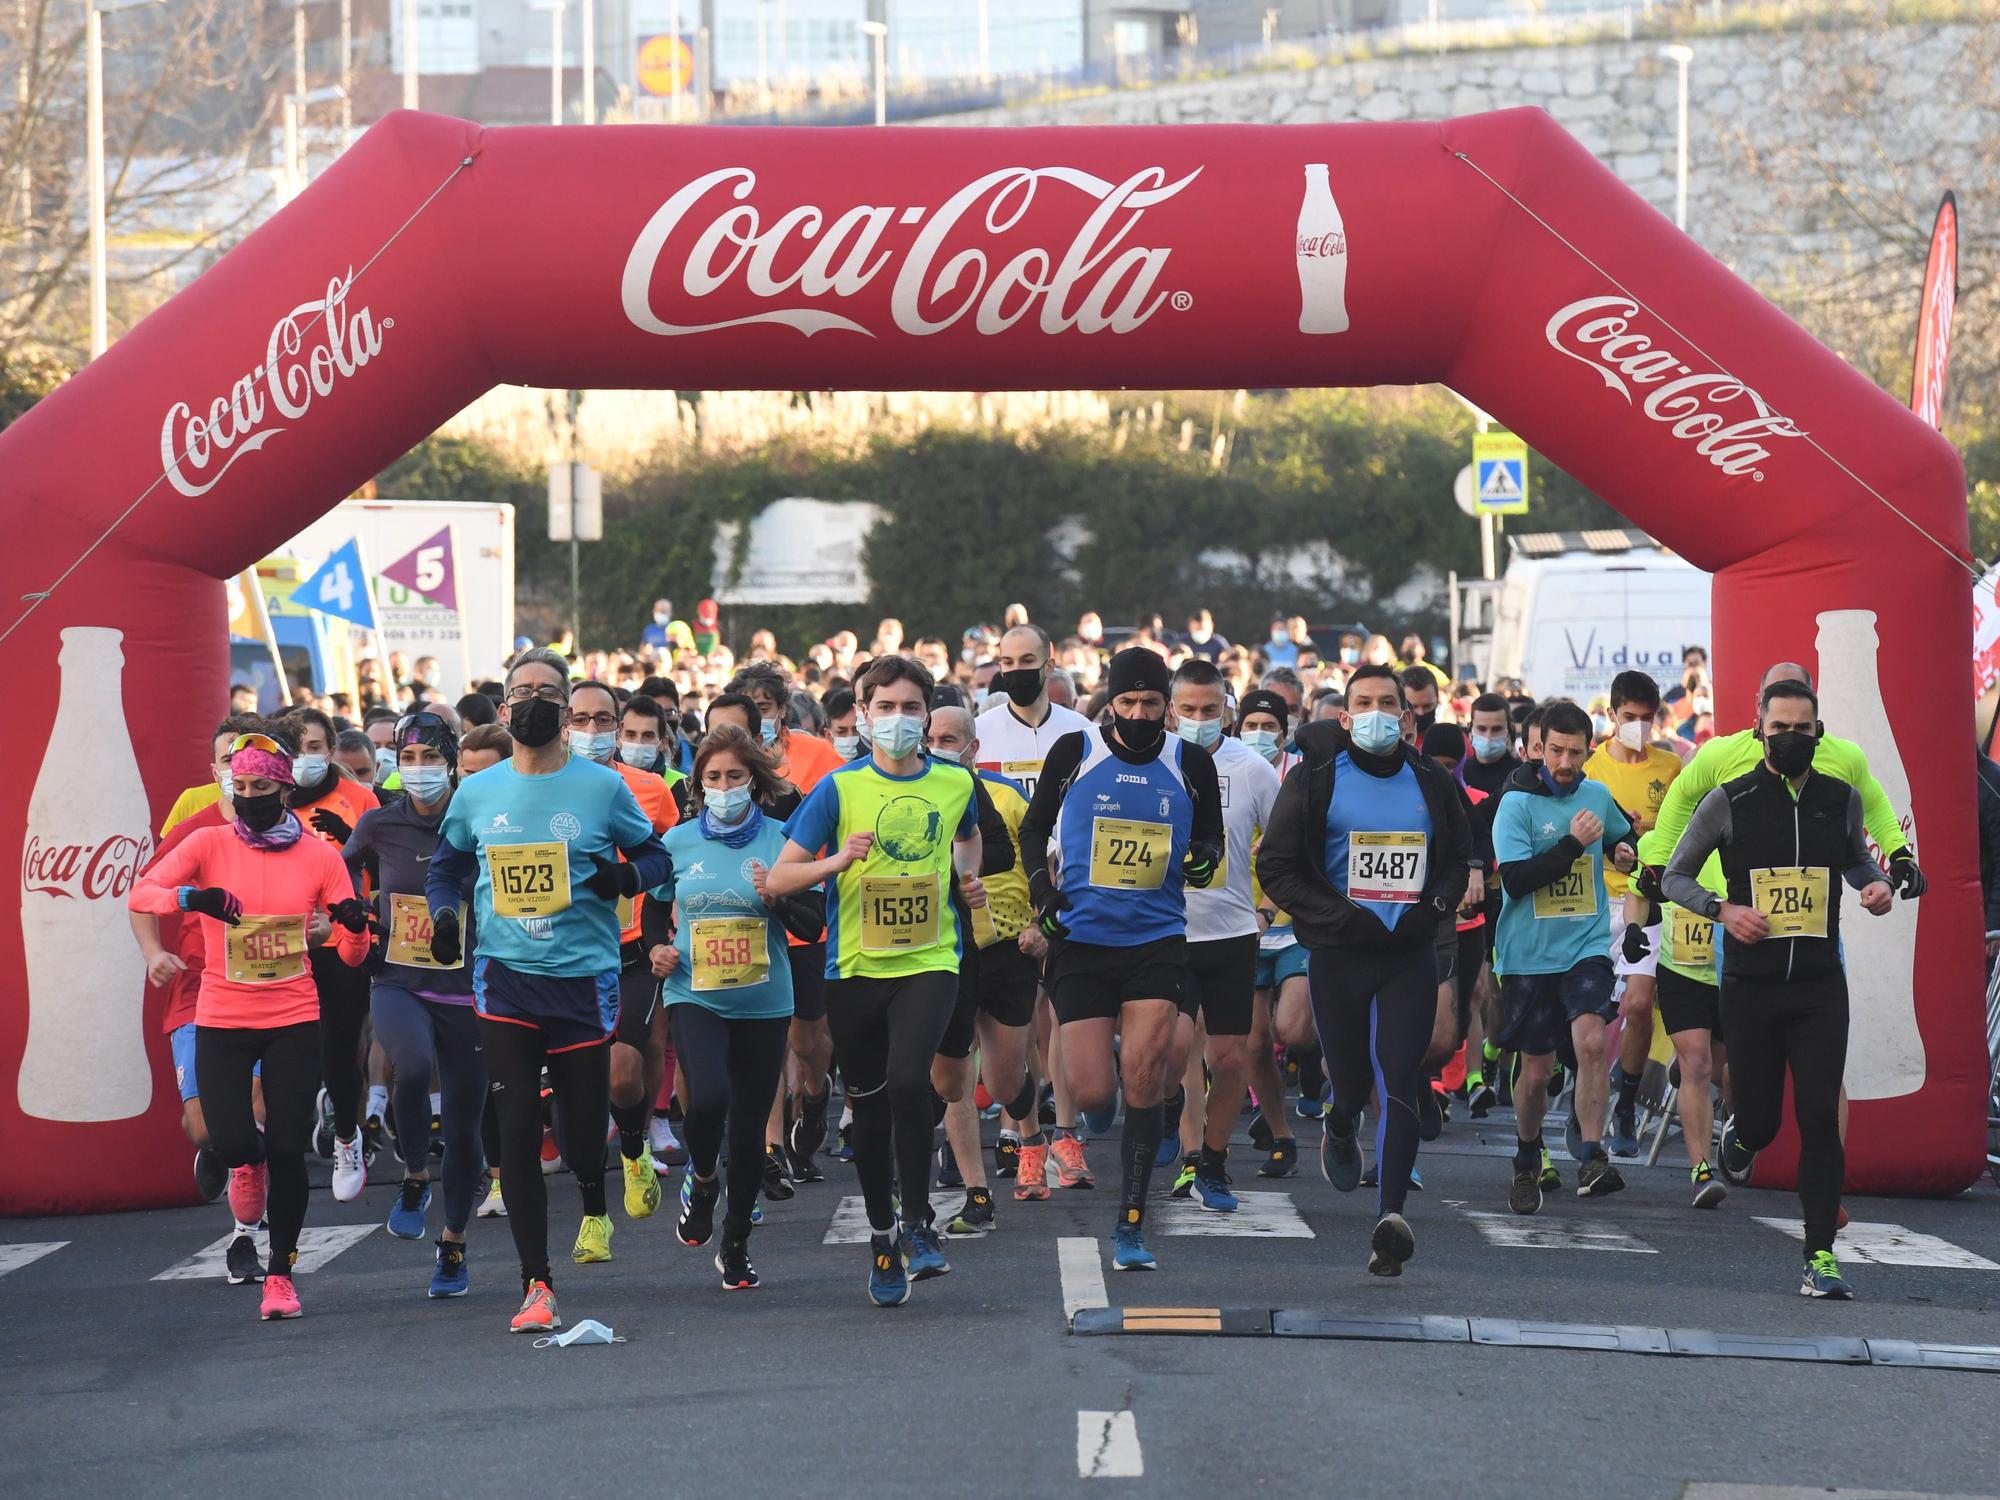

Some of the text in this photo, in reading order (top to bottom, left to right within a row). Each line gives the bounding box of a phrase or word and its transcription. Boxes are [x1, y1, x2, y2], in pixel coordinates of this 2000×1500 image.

[621, 165, 1204, 338] Coca-Cola
[161, 265, 382, 497] Coca-Cola
[1545, 296, 1809, 475] Coca-Cola
[416, 546, 444, 591] 5
[320, 562, 353, 610] 4
[24, 835, 150, 900] Coca-Col
[1108, 839, 1152, 867] 224
[1359, 852, 1419, 879] 3487
[501, 864, 553, 894] 1523
[874, 896, 928, 926] 1533
[1769, 887, 1813, 914] 284
[405, 915, 432, 944] 34
[242, 932, 289, 960] 365
[706, 938, 752, 967] 358
